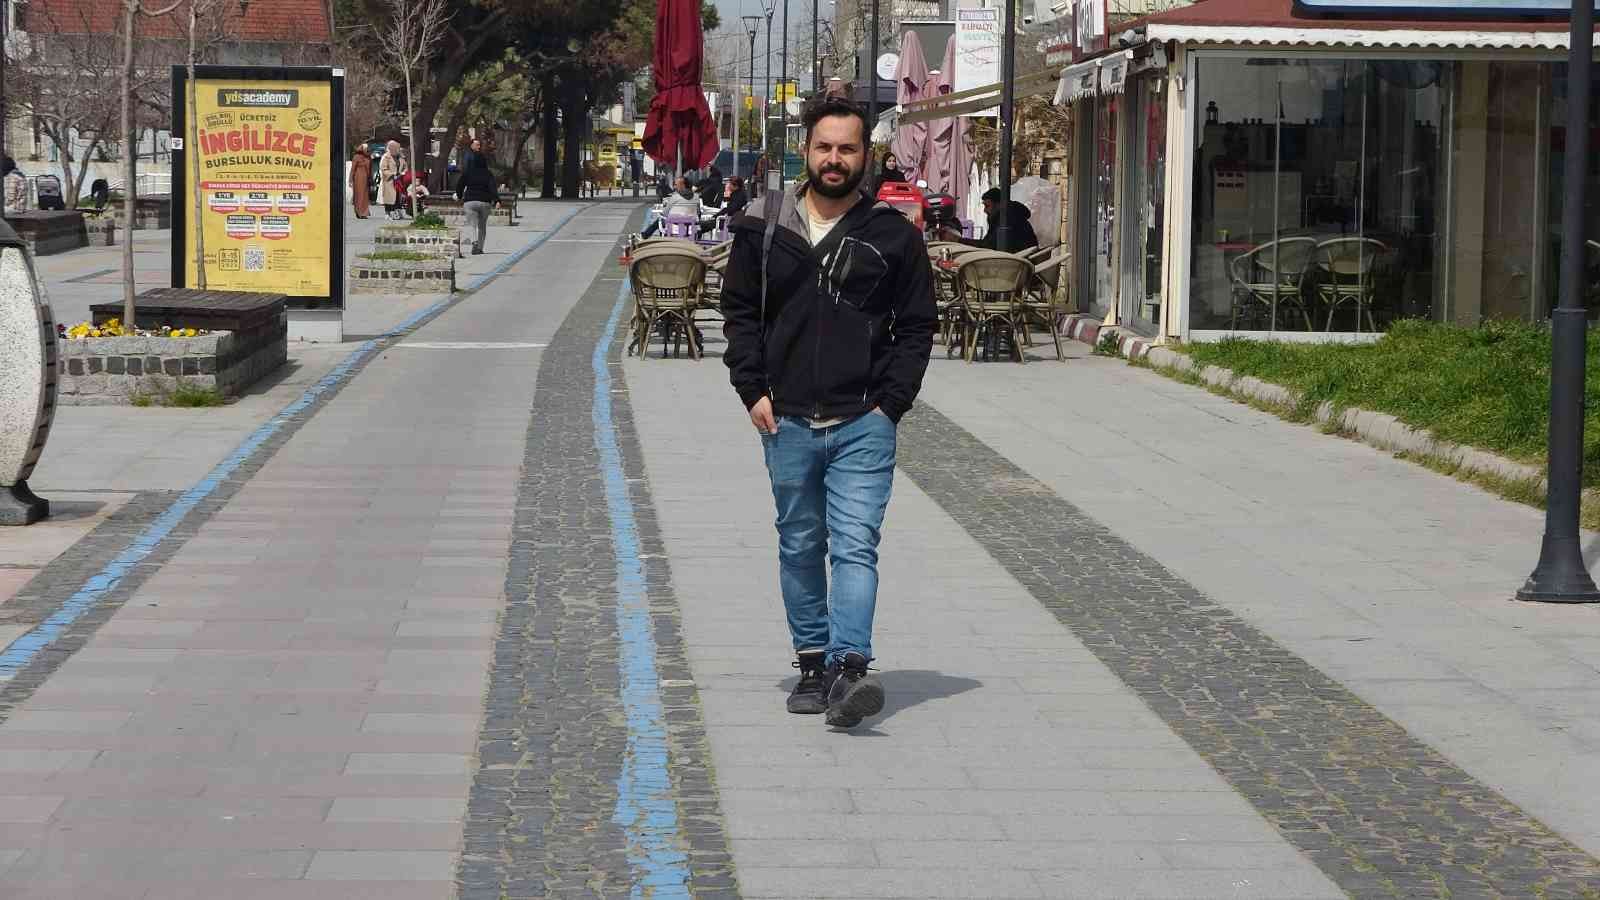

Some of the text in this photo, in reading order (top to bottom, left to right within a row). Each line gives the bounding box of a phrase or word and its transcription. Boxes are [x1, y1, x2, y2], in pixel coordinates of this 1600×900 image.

[224, 91, 291, 105] ydsacademy
[240, 113, 277, 122] ÜCRETSİZ
[199, 123, 318, 157] İNGİLİZCE
[206, 155, 313, 170] BURSLULUK SINAVI
